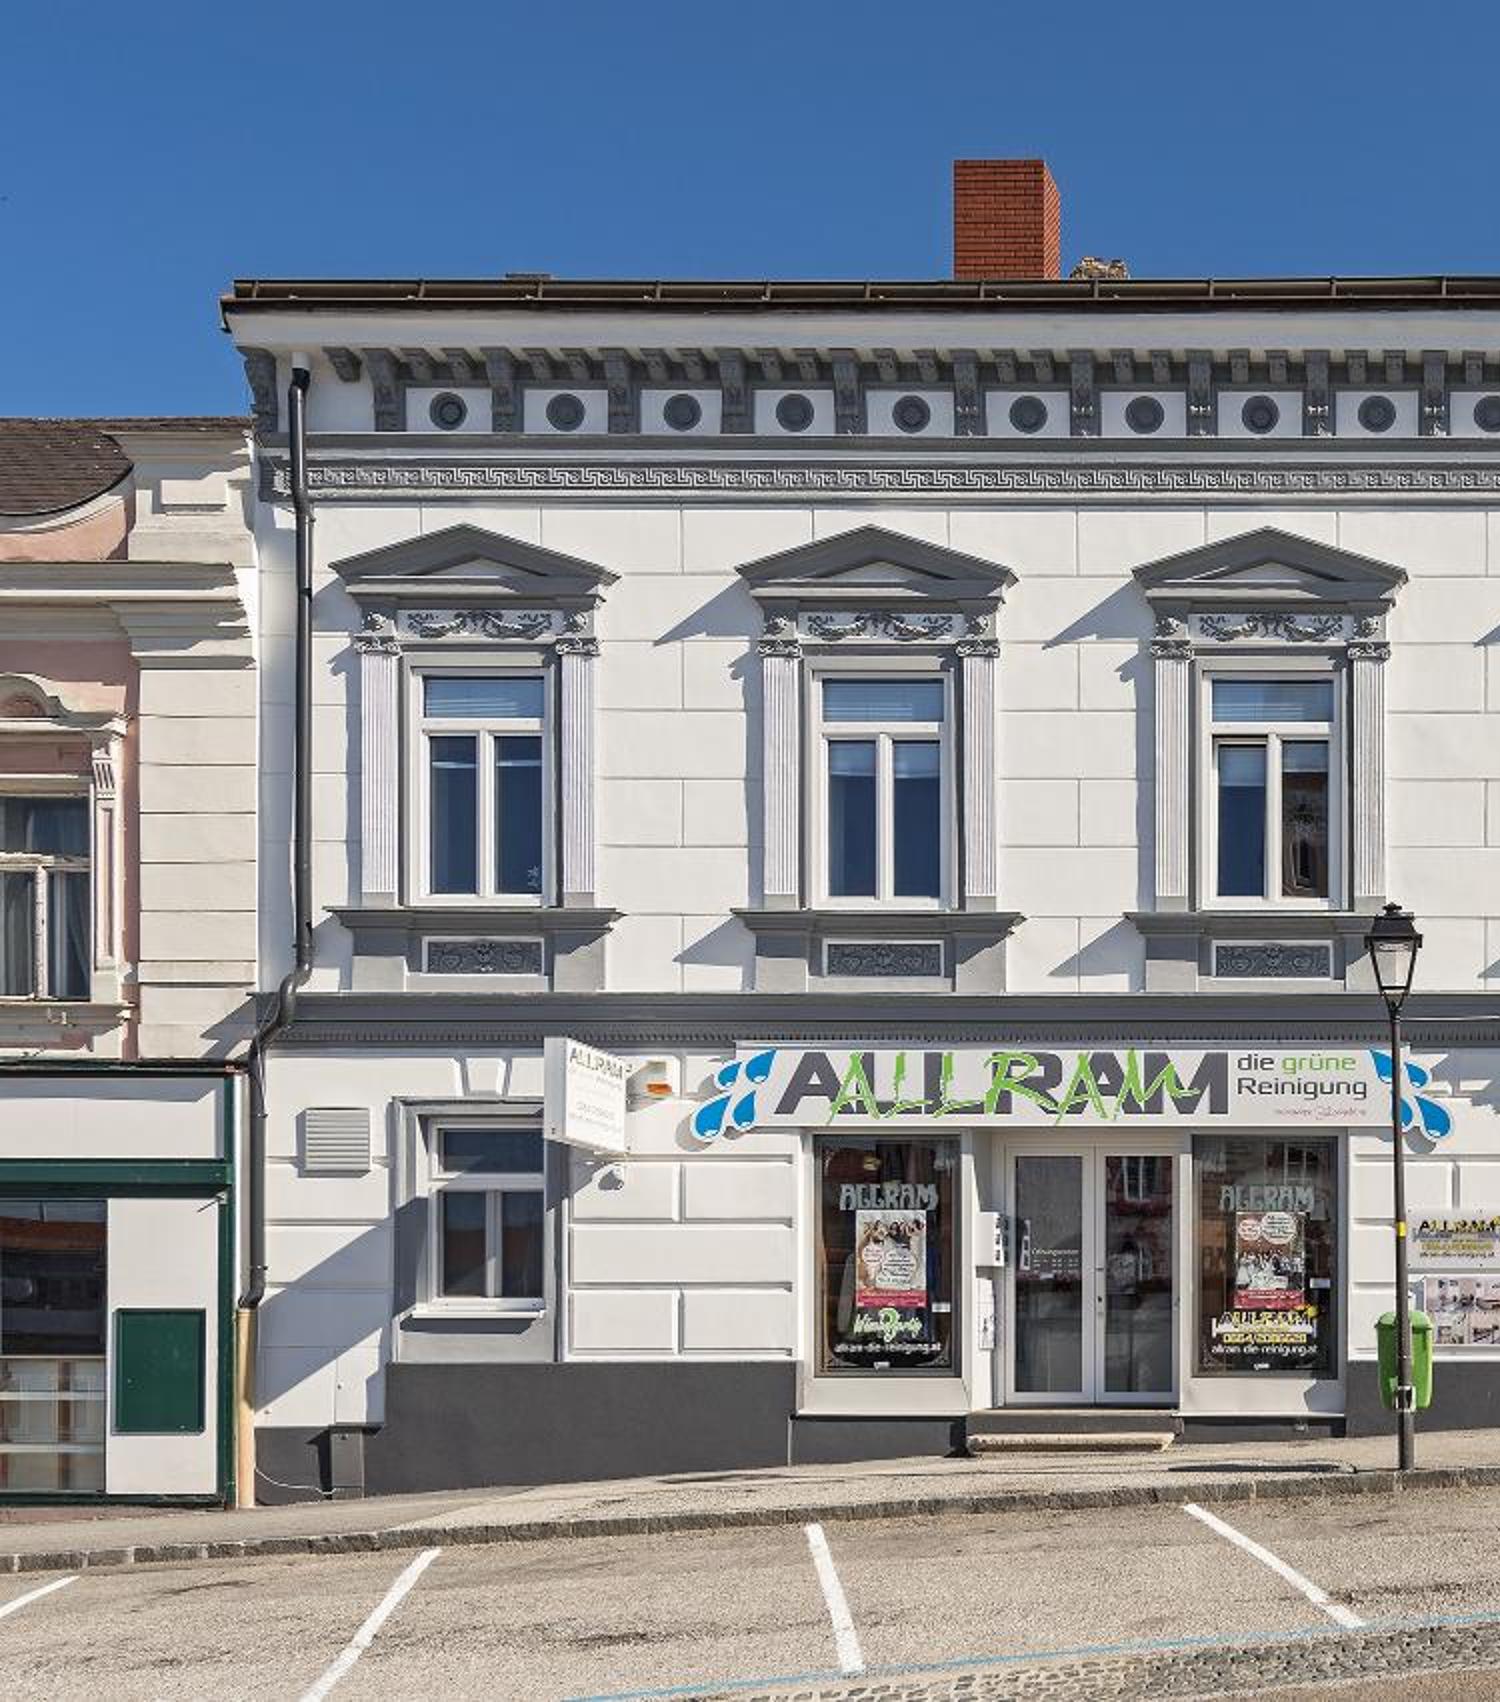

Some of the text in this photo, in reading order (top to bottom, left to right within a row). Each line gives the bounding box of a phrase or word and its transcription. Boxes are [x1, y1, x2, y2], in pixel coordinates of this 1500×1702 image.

[1237, 1053, 1357, 1075] die grüne
[774, 1051, 1228, 1115] ALLRAM
[1237, 1077, 1368, 1100] Reinigung
